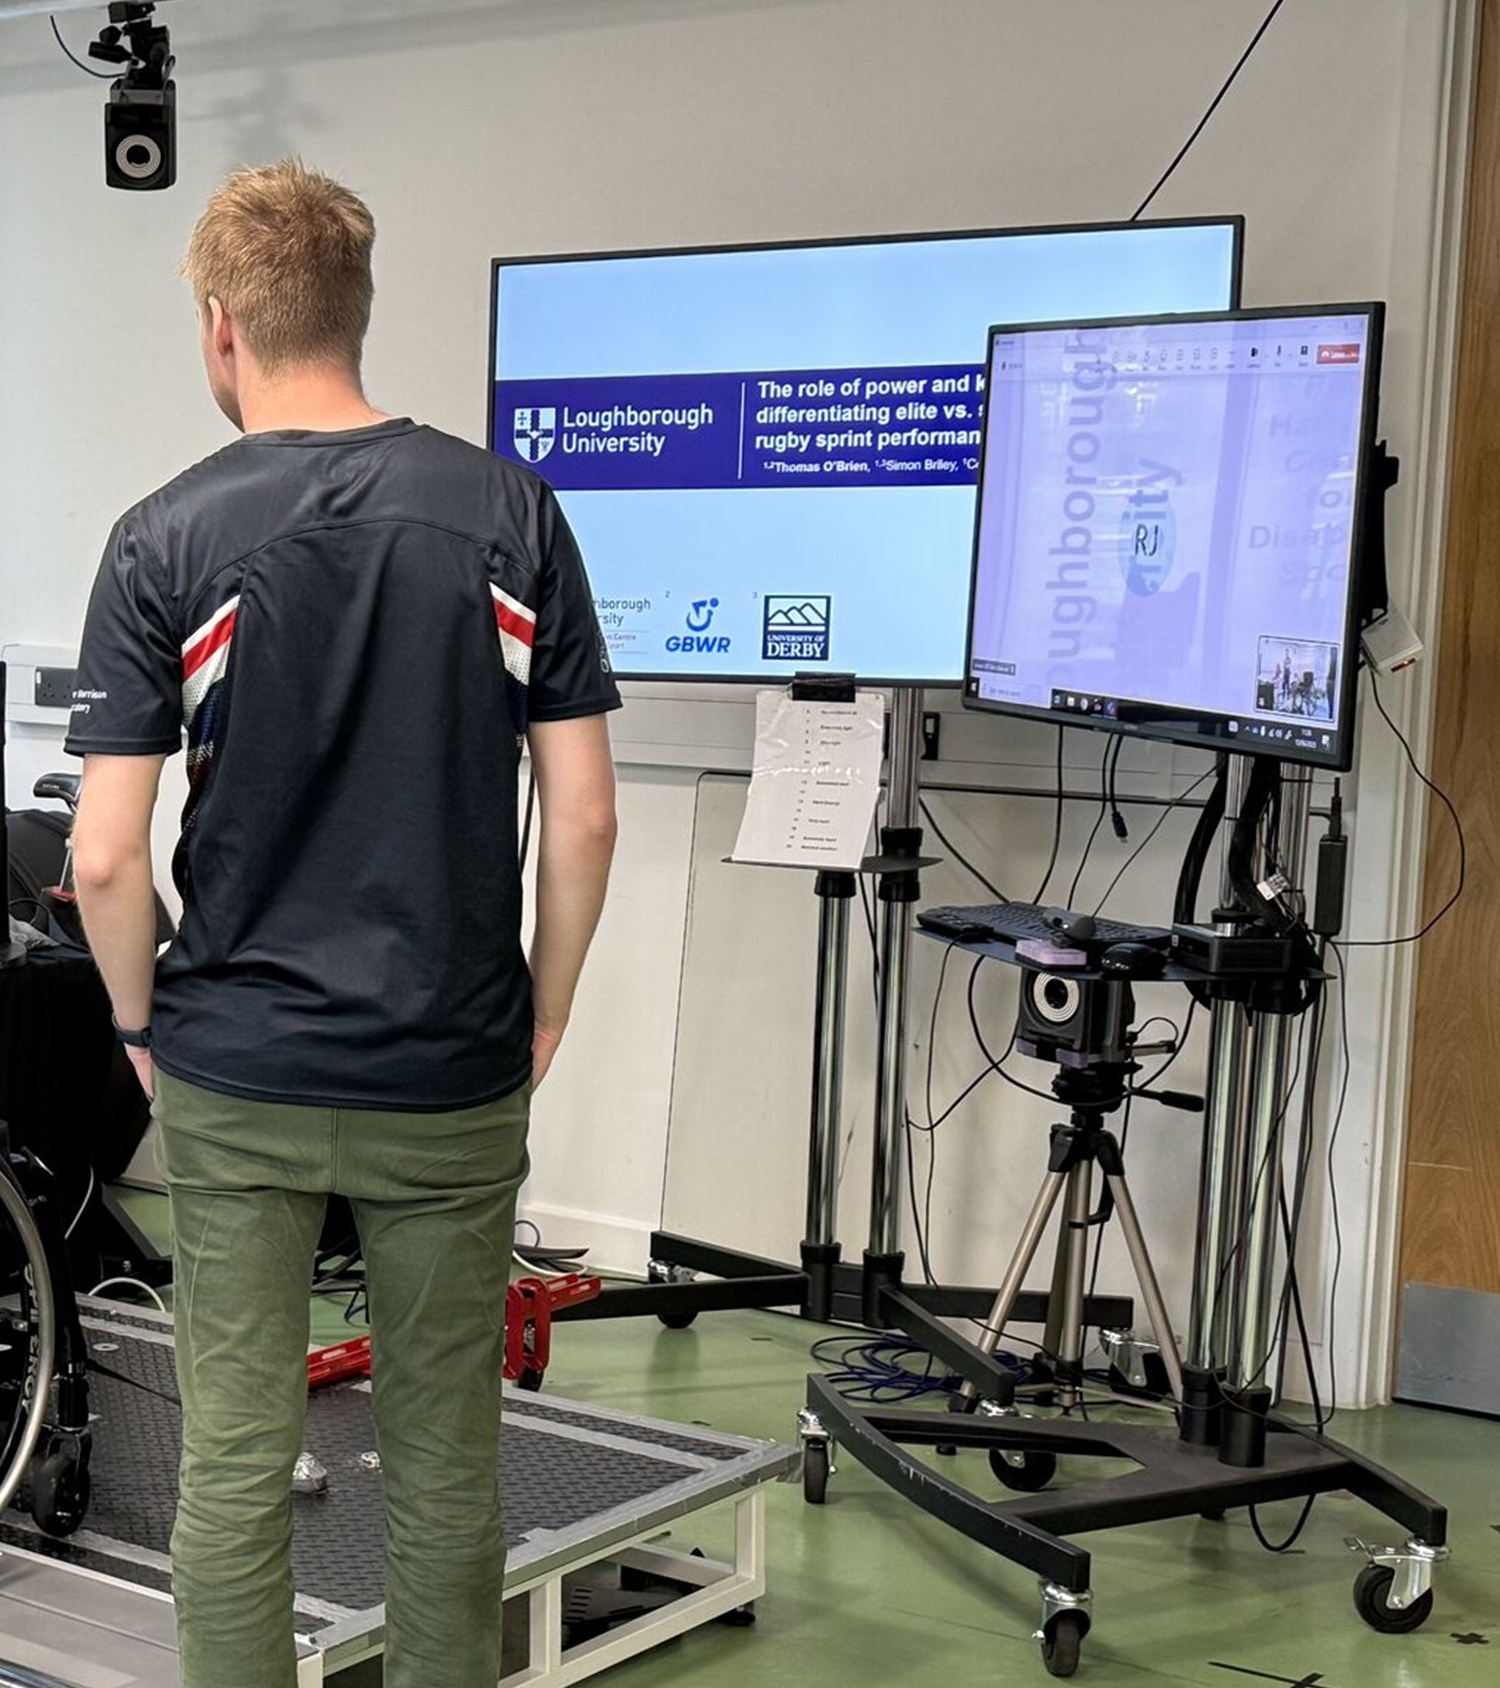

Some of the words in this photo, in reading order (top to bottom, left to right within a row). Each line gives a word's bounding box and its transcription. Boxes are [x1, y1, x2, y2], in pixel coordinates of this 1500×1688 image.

[757, 380, 793, 398] The
[798, 379, 835, 398] role
[840, 377, 861, 396] of
[865, 379, 927, 399] power
[932, 374, 970, 393] and
[563, 402, 713, 432] Loughborough
[755, 405, 891, 425] differentiating
[895, 402, 938, 421] elite
[943, 404, 973, 419] vs.
[562, 431, 666, 457] University
[755, 430, 811, 453] rugby
[815, 429, 873, 451] sprint
[877, 428, 982, 451] performan
[1134, 523, 1160, 557] RJ
[597, 596, 651, 613] borough
[665, 635, 732, 654] GBWR
[766, 642, 825, 659] DERBY
[767, 634, 810, 643] UNIVERSITY
[811, 634, 825, 643] OF
